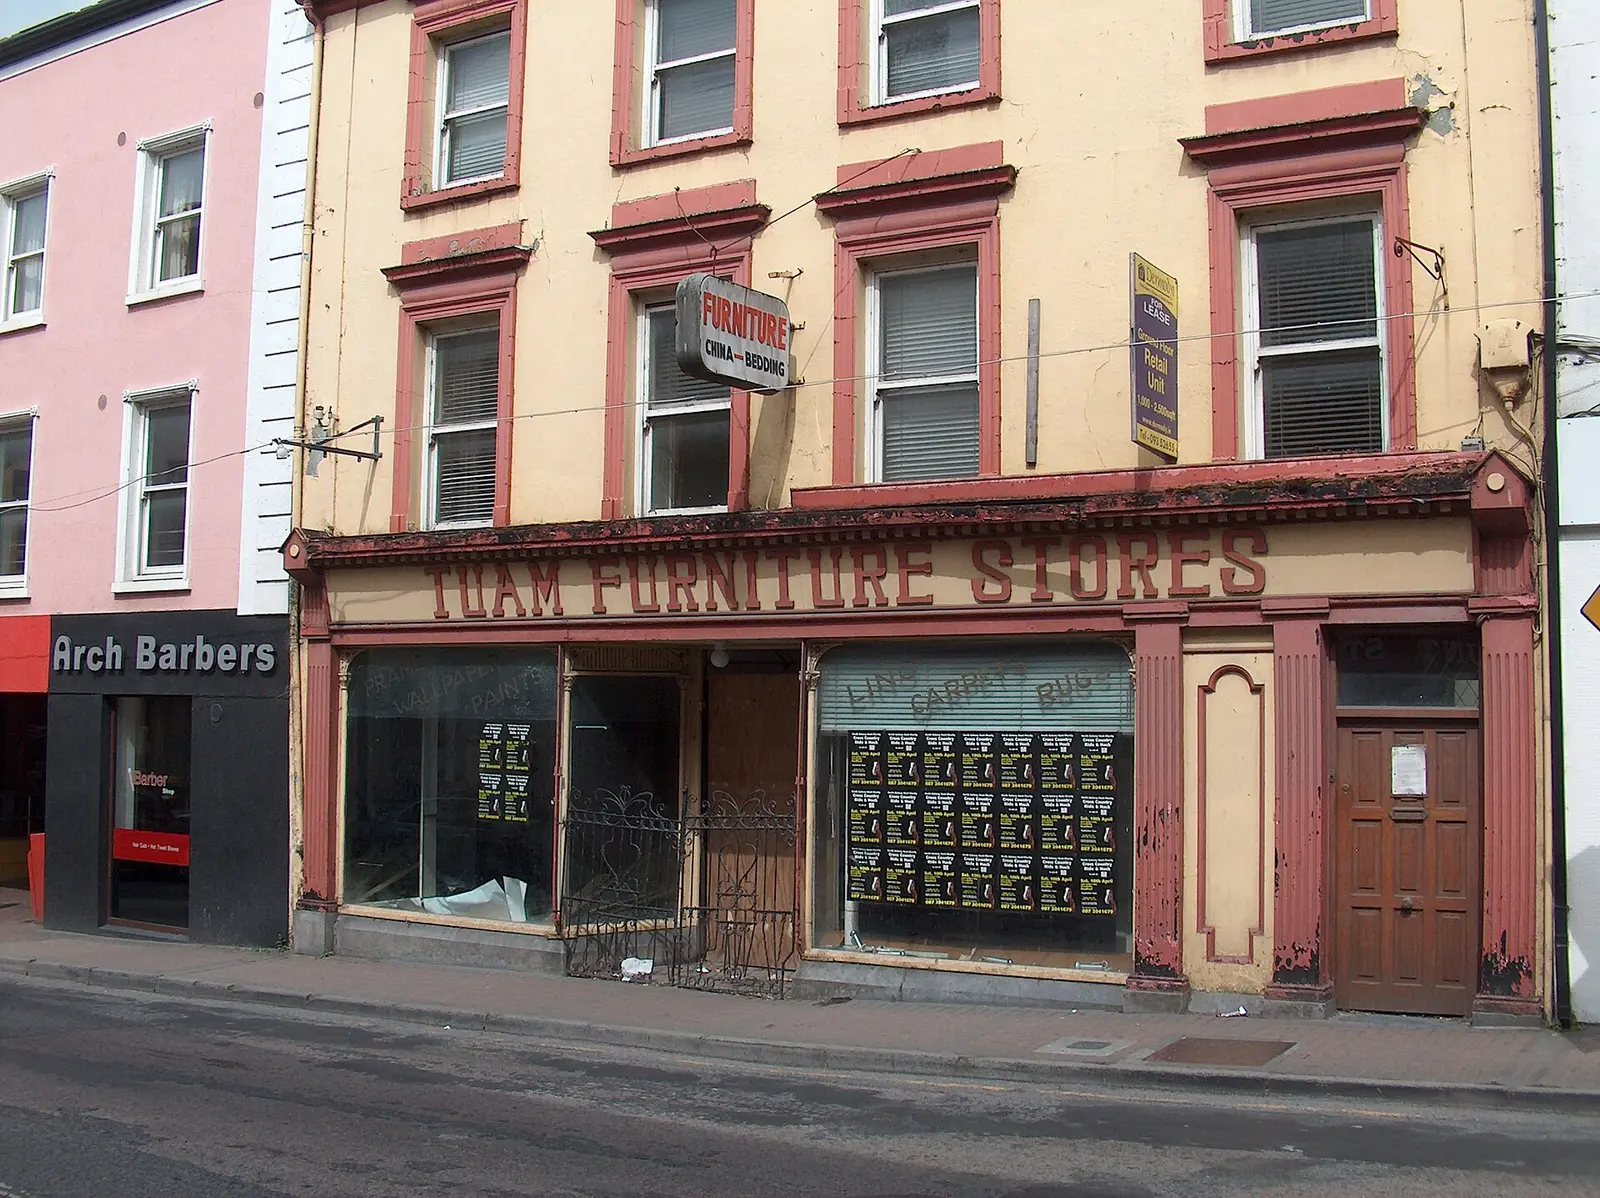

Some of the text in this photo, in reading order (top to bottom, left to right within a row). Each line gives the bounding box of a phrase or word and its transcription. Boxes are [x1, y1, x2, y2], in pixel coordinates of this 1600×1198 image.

[1143, 301, 1171, 326] LEASE
[1151, 298, 1163, 311] FOR
[703, 291, 787, 351] FURNITURE
[1144, 347, 1168, 375] Retail
[1147, 370, 1165, 395] Unit
[425, 527, 1268, 619] TUAM FURNITURE STORES
[53, 634, 277, 672] Arch Barbers
[134, 770, 168, 787] Barber
[162, 787, 175, 796] Shop
